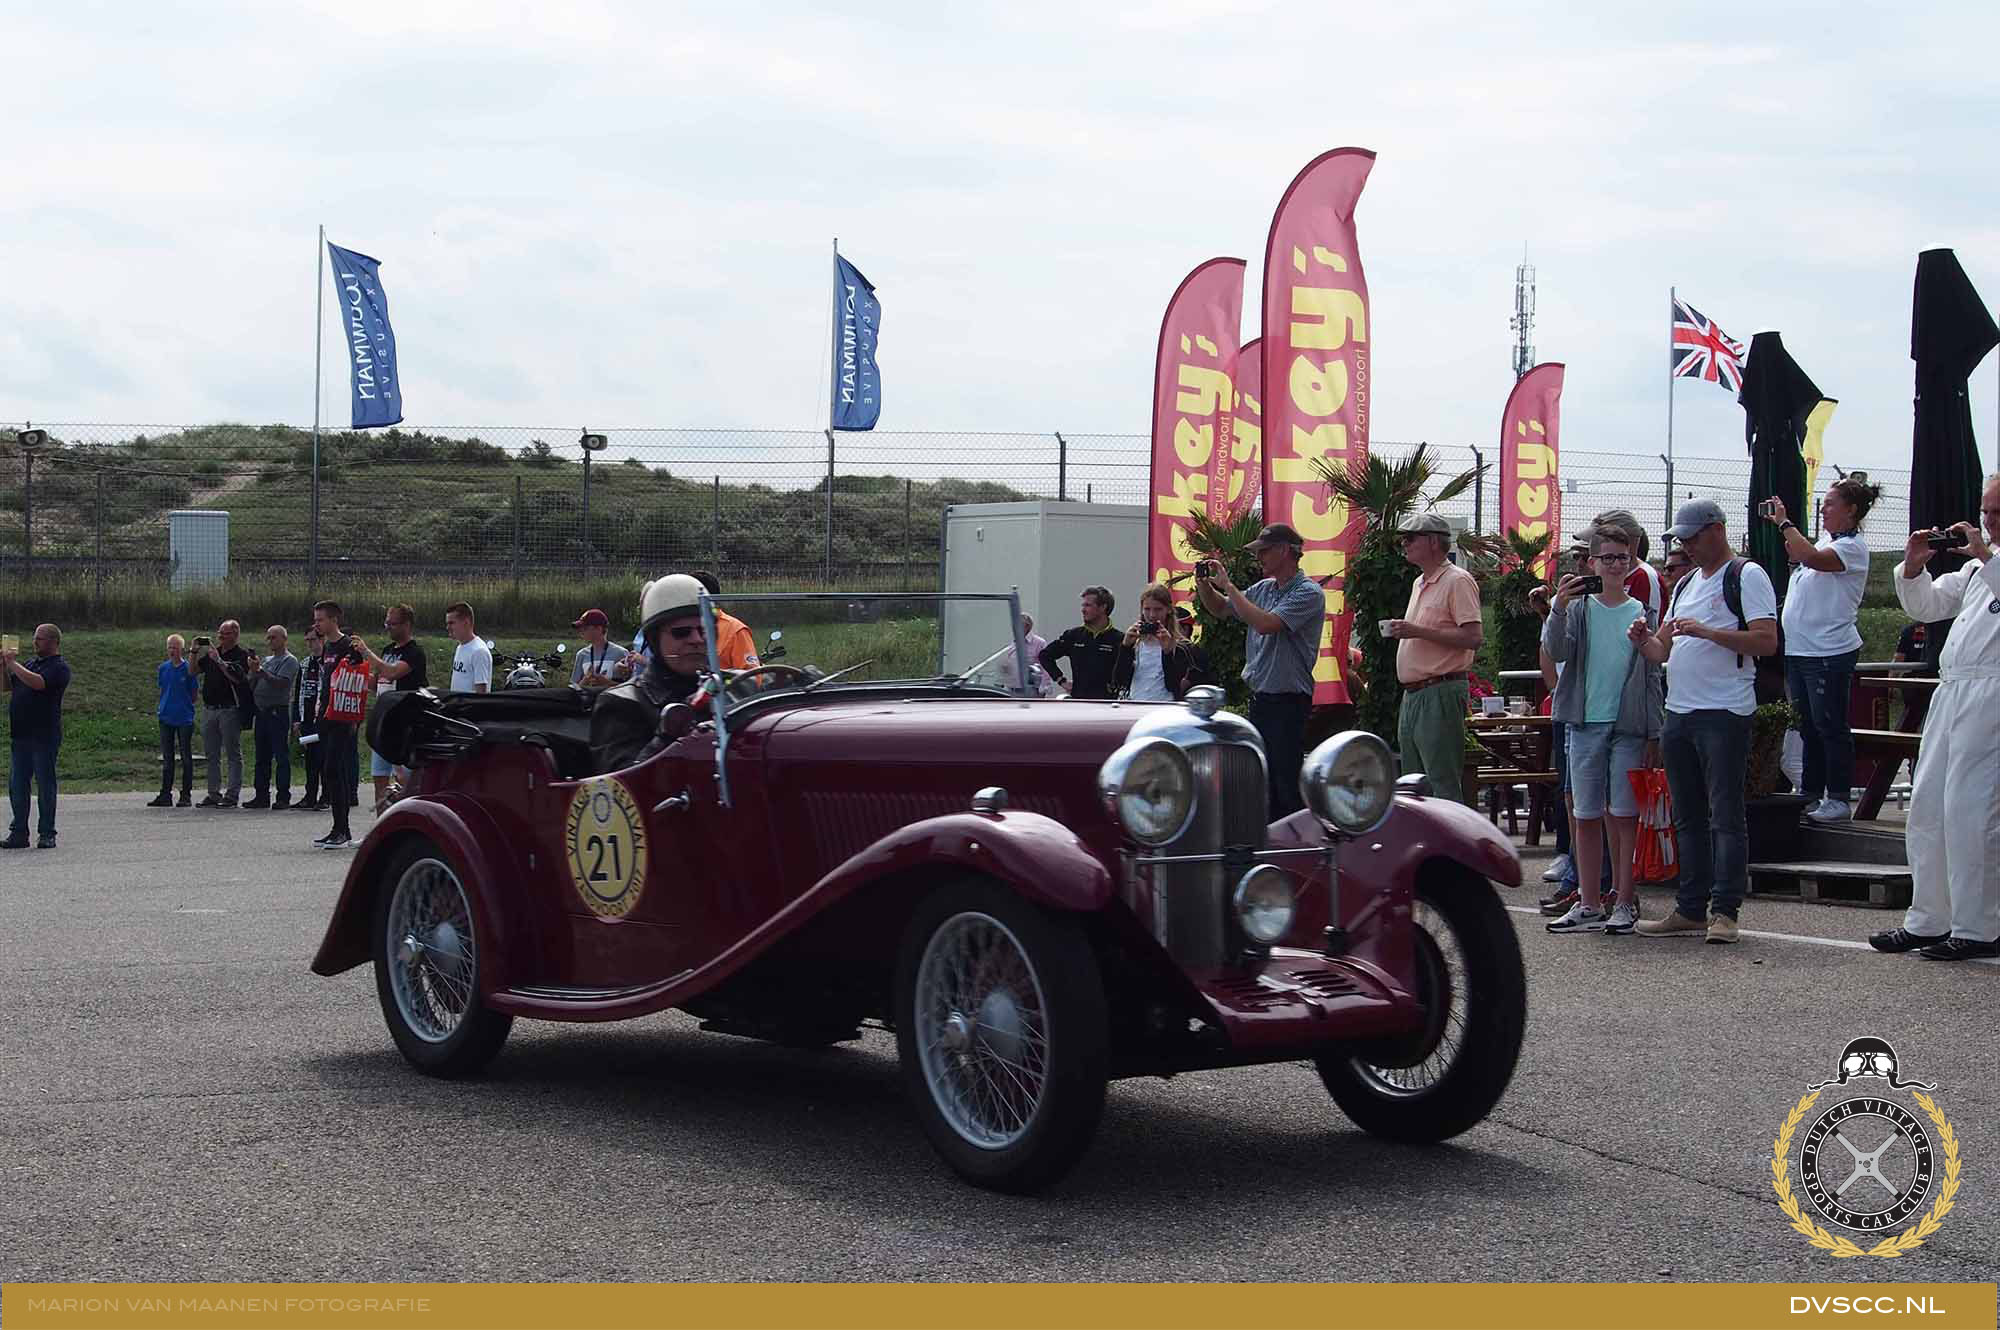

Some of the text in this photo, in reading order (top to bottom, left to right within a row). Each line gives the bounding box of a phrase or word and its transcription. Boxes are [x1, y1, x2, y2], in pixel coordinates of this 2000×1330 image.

[1353, 348, 1367, 433] Zandvoort
[1216, 416, 1229, 484] Zandvoort
[333, 691, 361, 713] Week
[567, 781, 647, 857] VINTAGE REVIVAL
[587, 834, 622, 882] 21
